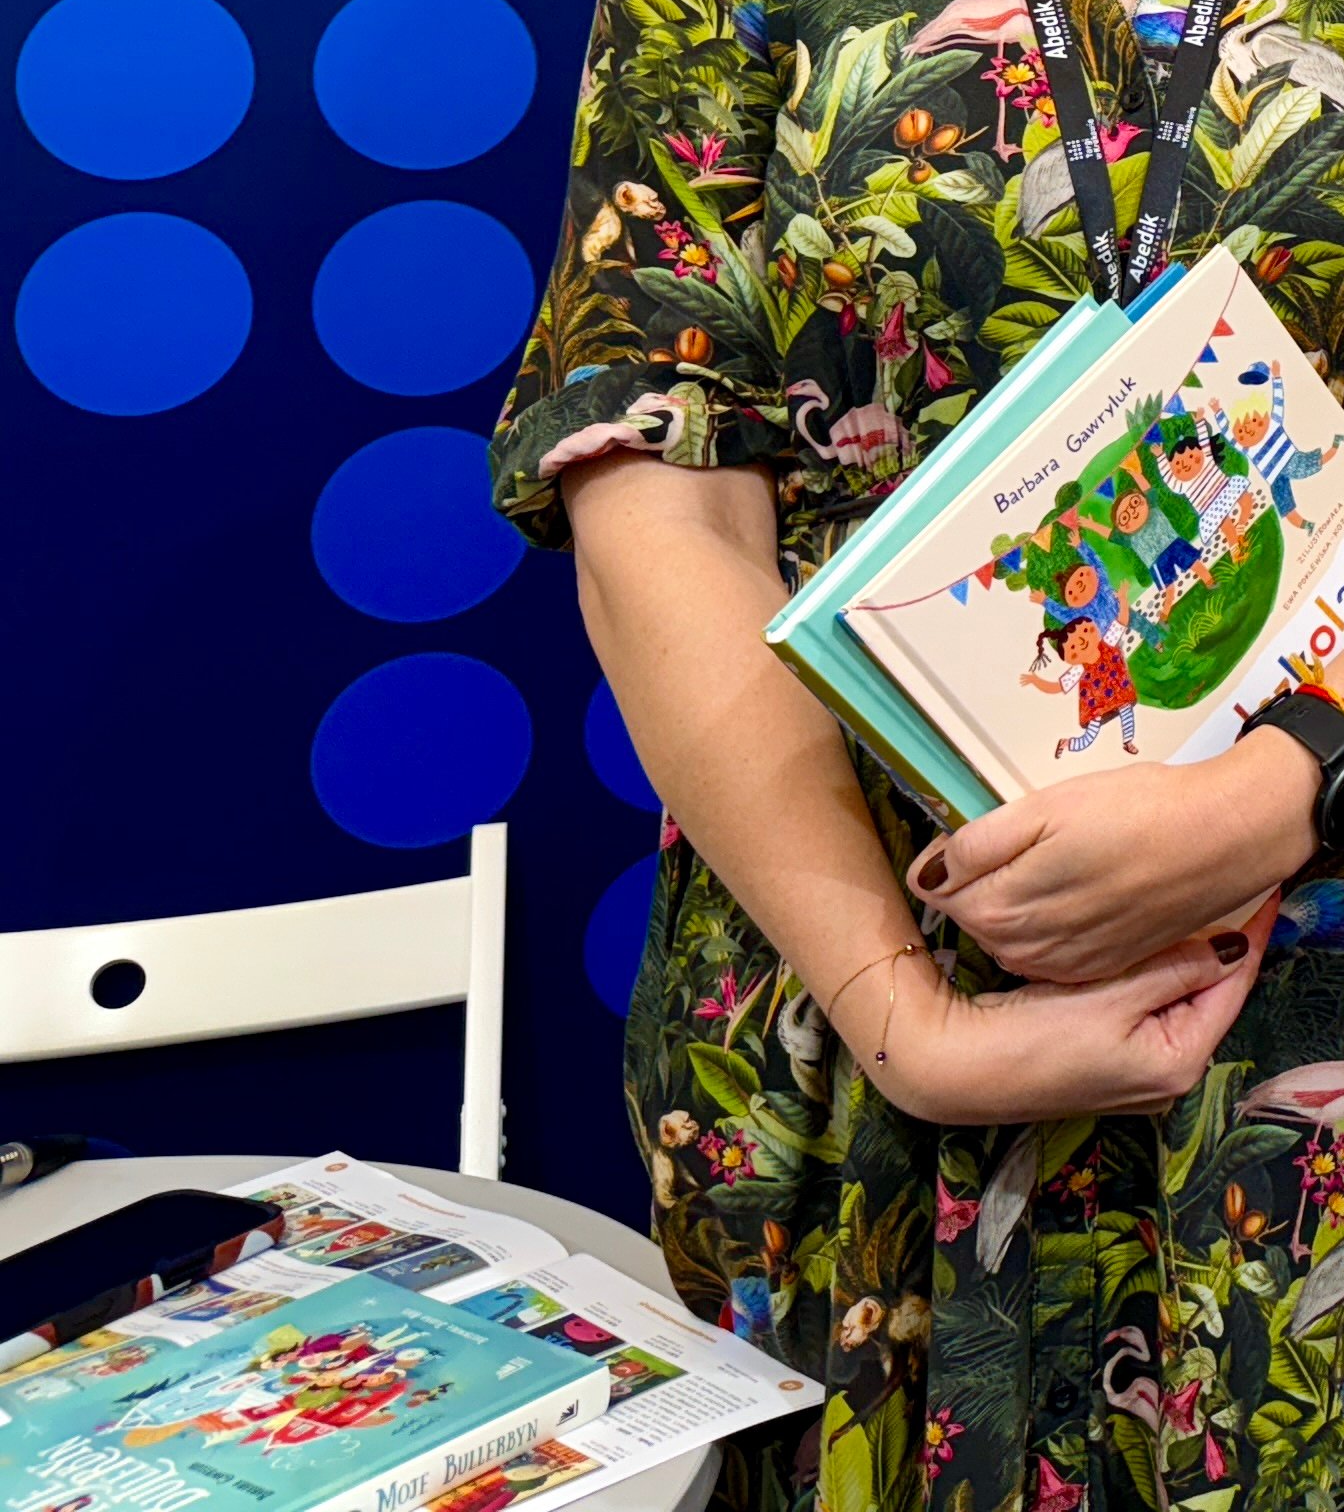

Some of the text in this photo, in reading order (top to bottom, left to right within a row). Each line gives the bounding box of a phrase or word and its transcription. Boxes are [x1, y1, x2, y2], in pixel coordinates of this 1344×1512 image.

[1032, 0, 1069, 59] Abedik
[1129, 212, 1160, 284] Abedik
[993, 376, 1137, 514] Barbara Gawryluk
[1282, 590, 1299, 611] EWA
[442, 1418, 539, 1486] BULLERBYN
